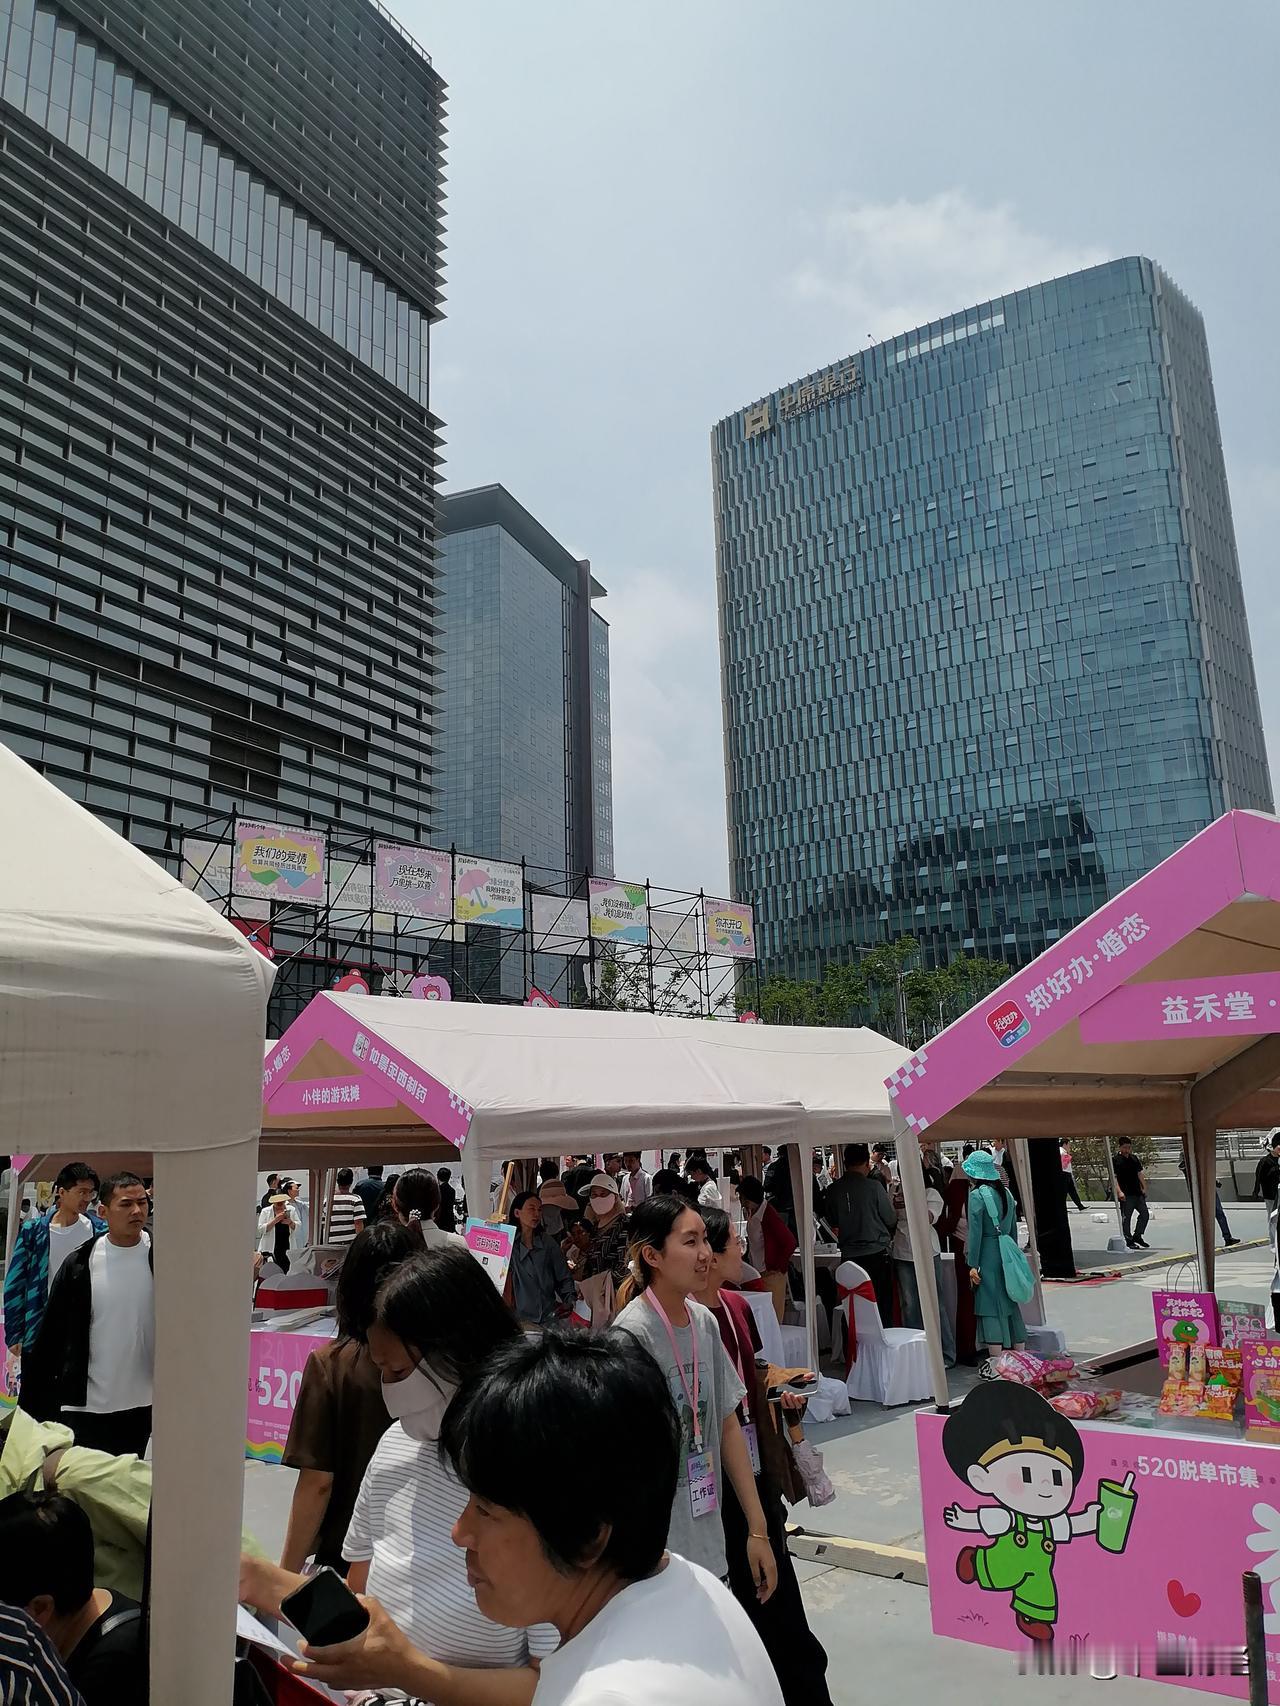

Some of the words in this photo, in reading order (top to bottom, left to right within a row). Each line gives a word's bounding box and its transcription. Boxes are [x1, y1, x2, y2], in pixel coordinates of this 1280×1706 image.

[780, 362, 857, 413] 中原银行
[833, 382, 862, 398] BANK
[253, 845, 308, 865] 我们的爱情
[714, 916, 743, 930] 你不开口
[1024, 912, 1151, 1017] 郑好办·婚恋
[263, 1044, 291, 1087] 办·婚恋
[368, 1046, 429, 1104] 仲景宛西制药
[302, 1085, 360, 1105] 小伴的游戏摊
[1137, 1455, 1260, 1489] 520脱单市集
